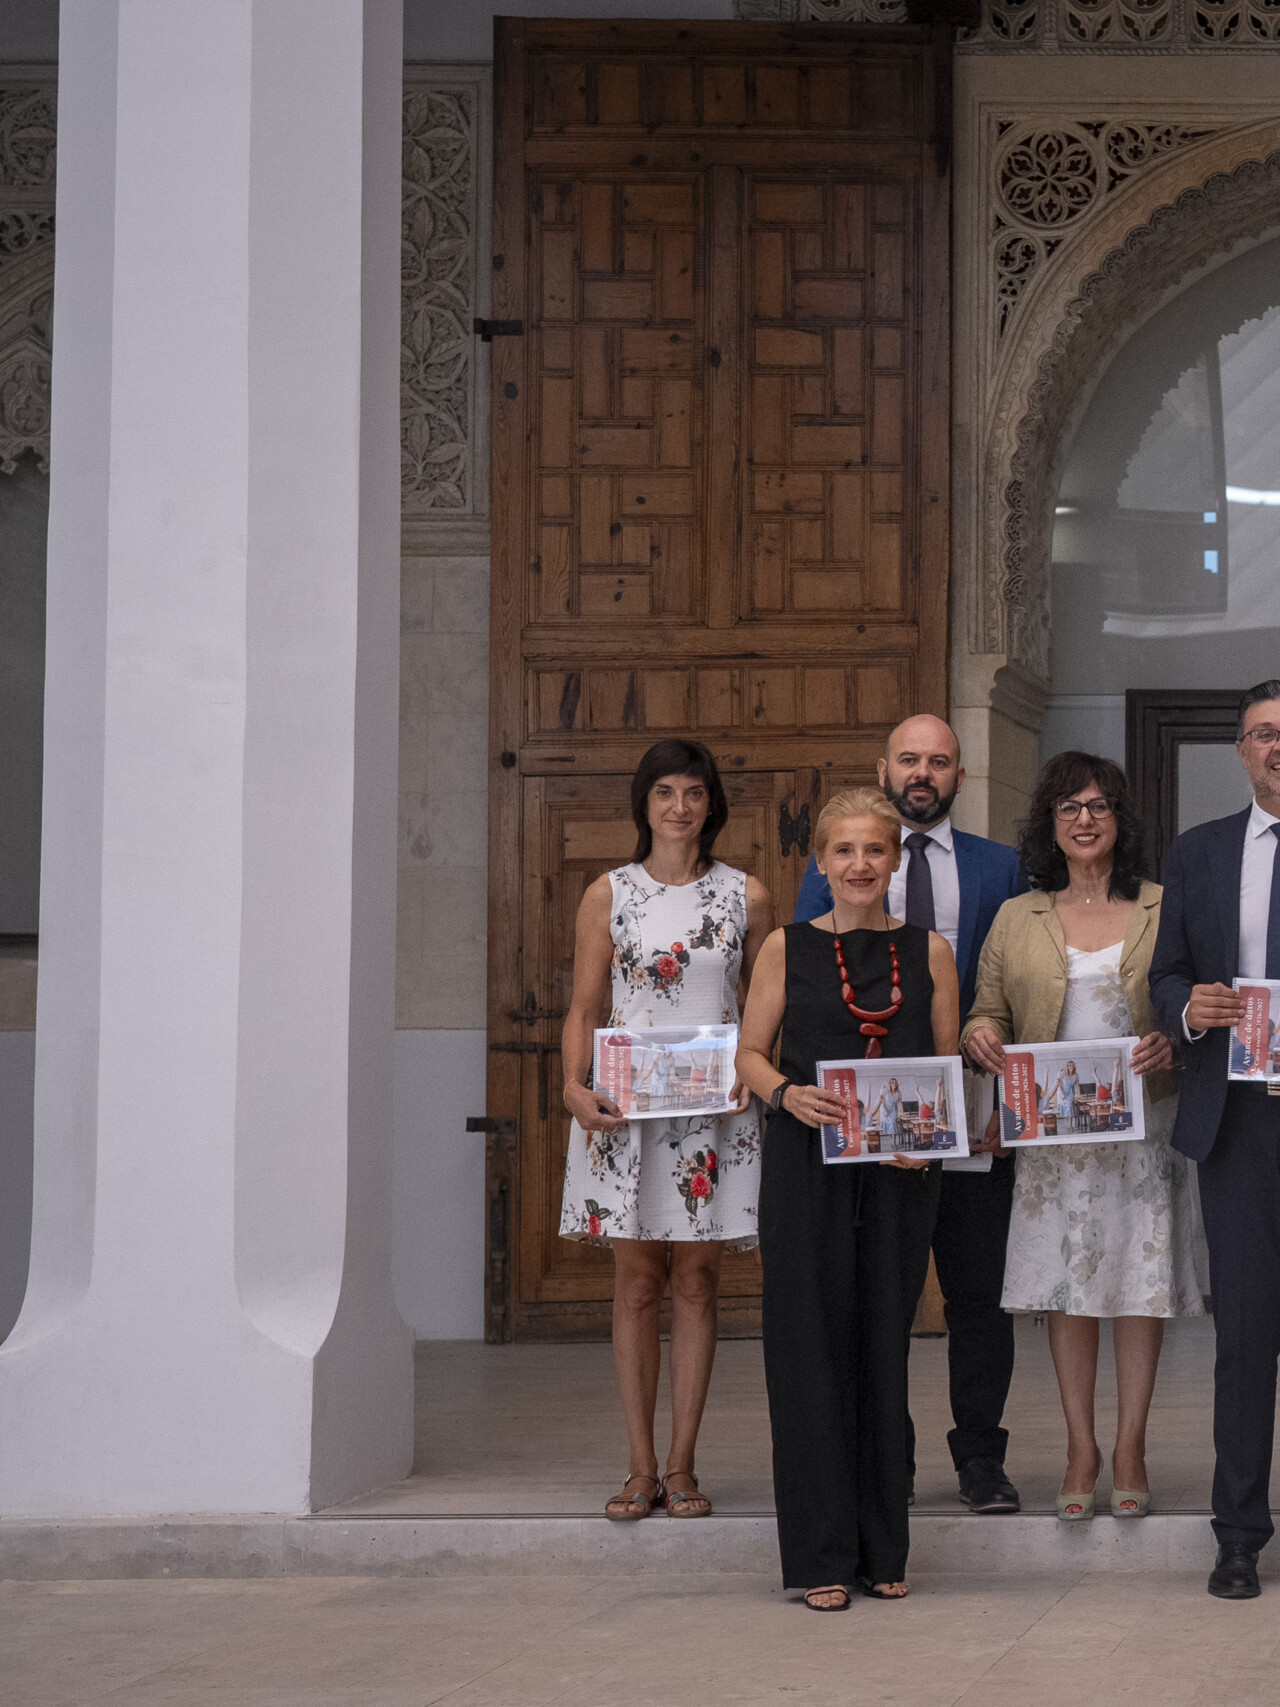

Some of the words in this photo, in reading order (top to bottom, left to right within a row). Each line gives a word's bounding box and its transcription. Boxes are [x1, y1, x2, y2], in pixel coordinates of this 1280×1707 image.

[1245, 997, 1254, 1020] datos
[1244, 1023, 1252, 1033] de
[1011, 1063, 1019, 1086] datos
[1012, 1088, 1020, 1098] de
[1014, 1101, 1022, 1132] Avance
